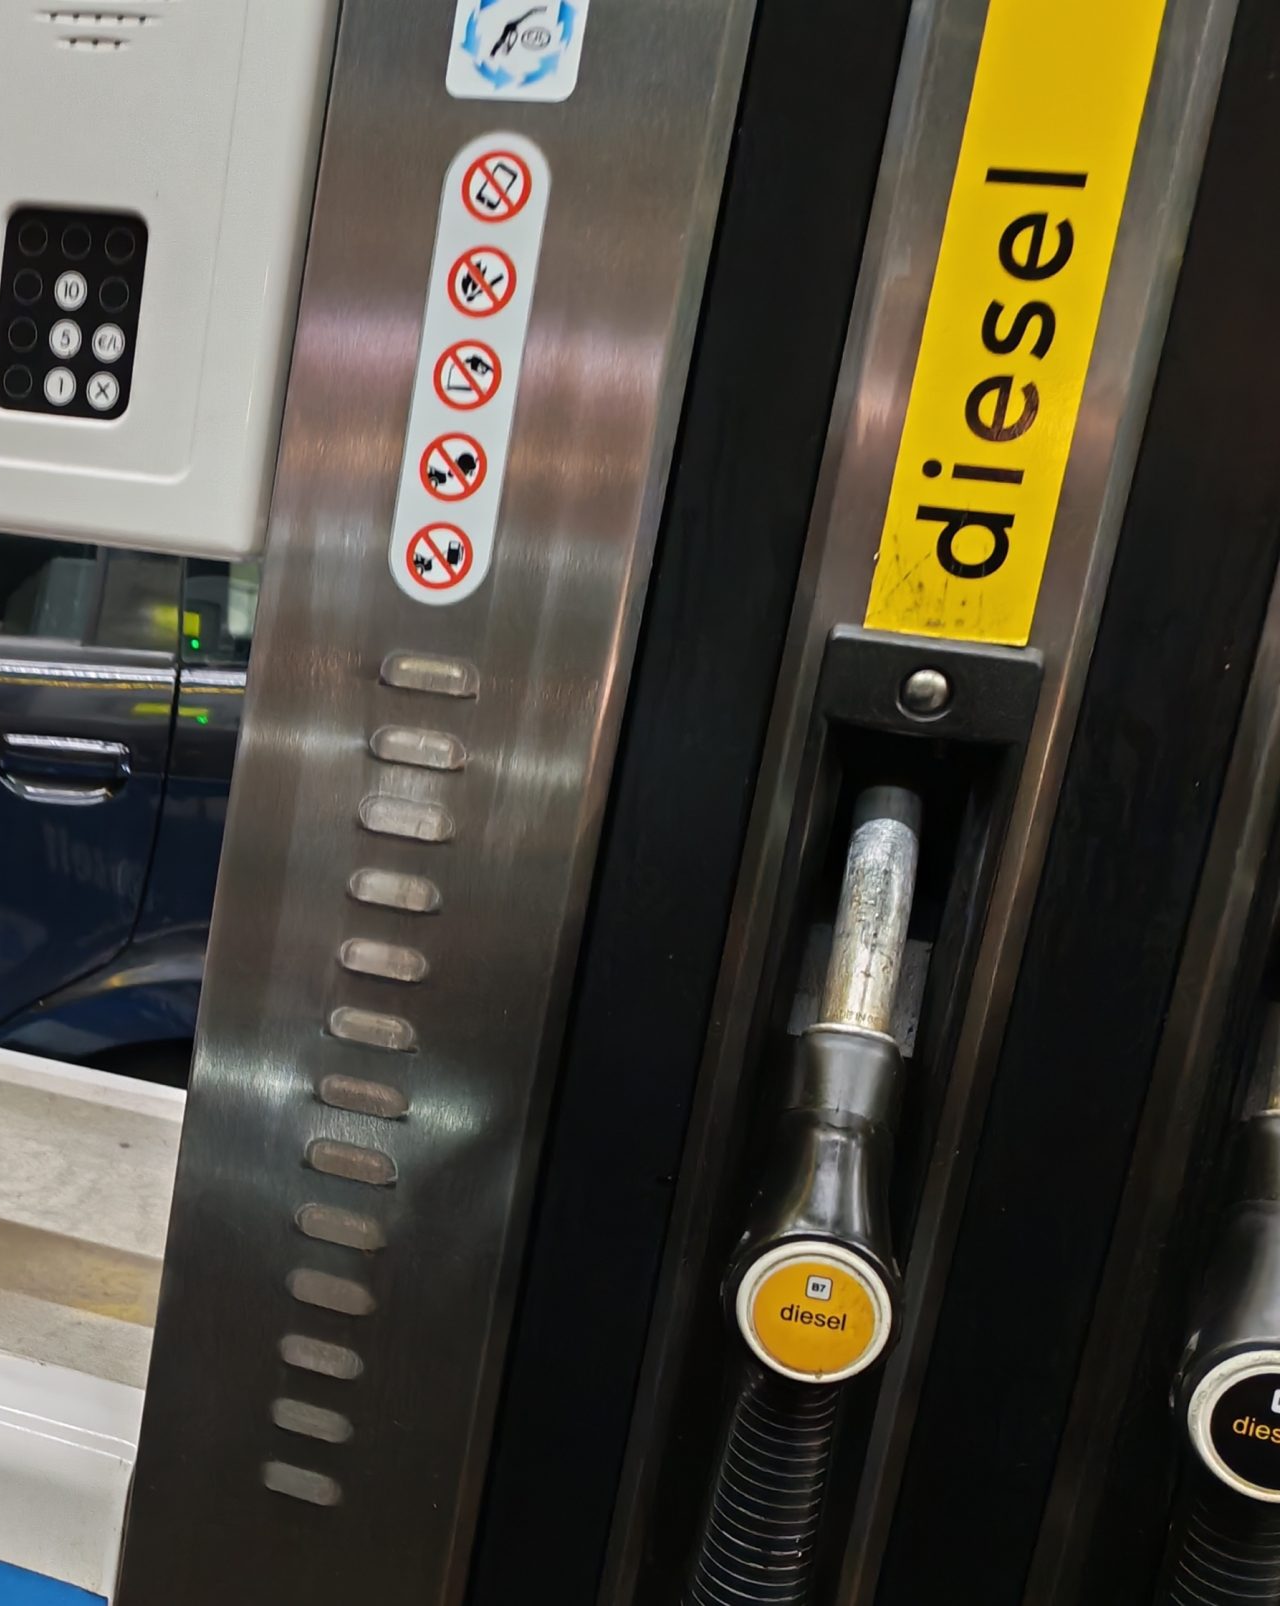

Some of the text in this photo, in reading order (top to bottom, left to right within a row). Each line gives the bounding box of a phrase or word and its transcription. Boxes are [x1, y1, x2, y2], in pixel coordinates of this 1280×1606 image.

[62, 281, 80, 300] 10
[59, 328, 71, 348] 5
[916, 166, 1088, 579] diesel
[811, 1282, 827, 1293] B7
[780, 1303, 847, 1331] diesel
